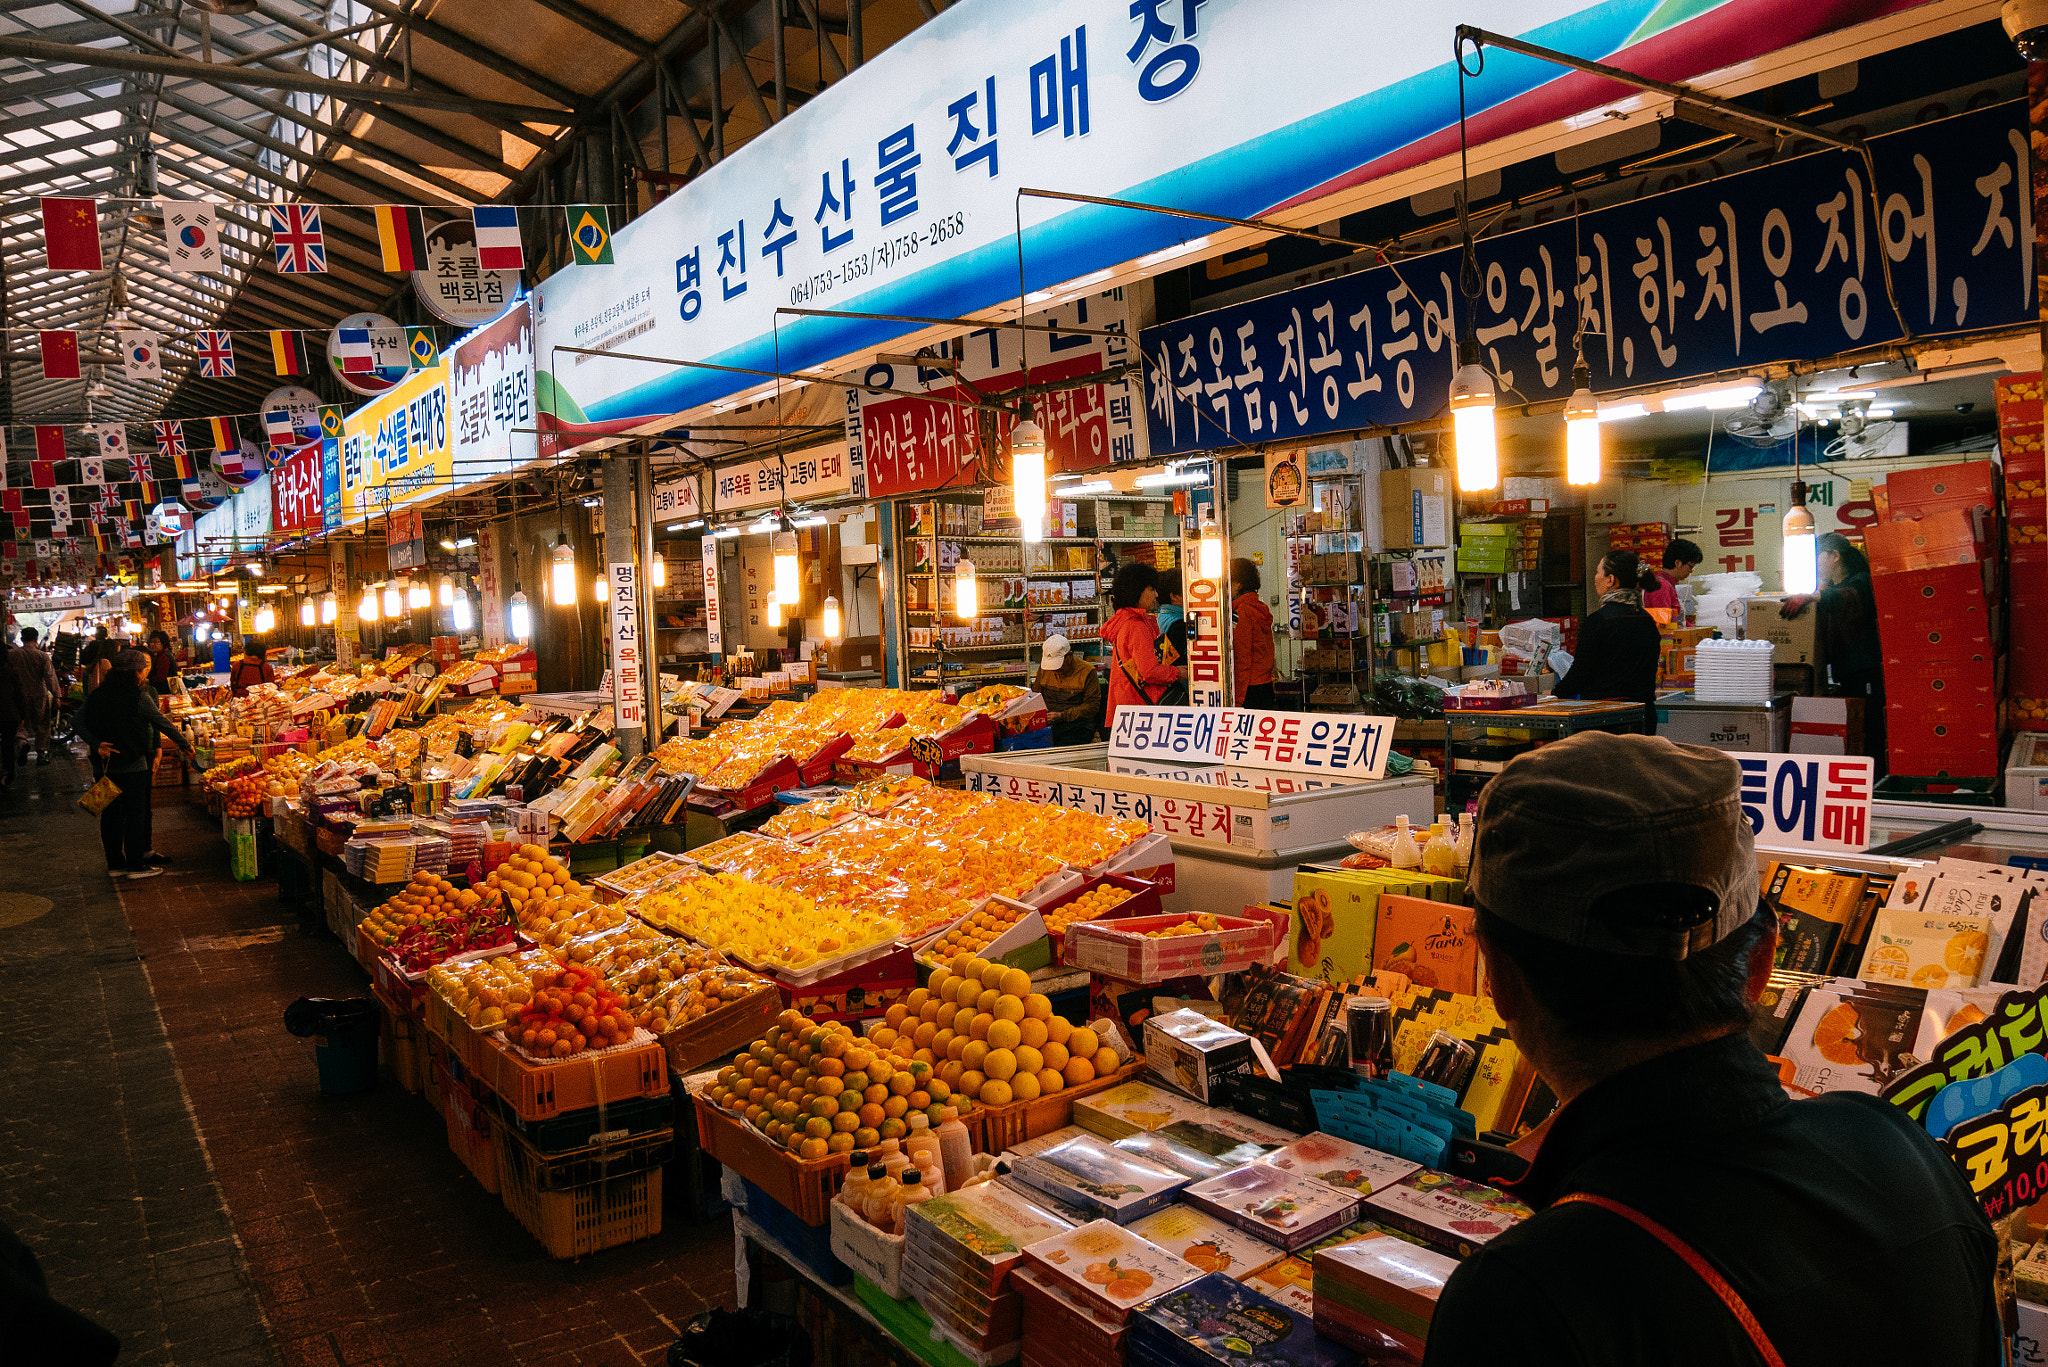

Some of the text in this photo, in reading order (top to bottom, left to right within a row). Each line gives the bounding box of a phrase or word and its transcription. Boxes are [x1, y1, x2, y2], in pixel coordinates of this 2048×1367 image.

[437, 256, 501, 279] 초콜
[439, 280, 505, 304] 백화점
[410, 384, 447, 458] 직매장
[459, 366, 529, 446] 초콜릿 백화점
[789, 458, 817, 485] 고등어
[821, 453, 842, 479] 도매
[845, 388, 866, 498] 전국택배
[277, 449, 322, 527] 한라수산
[655, 486, 692, 511] 고등어 도매
[705, 566, 718, 621] 옥돔
[615, 566, 640, 722] 명진수산 옥돔도매
[1115, 711, 1216, 754] 진공고등어
[1230, 713, 1255, 761] 제주
[1822, 761, 1869, 846] 도매
[1424, 932, 1465, 951] Tarts
